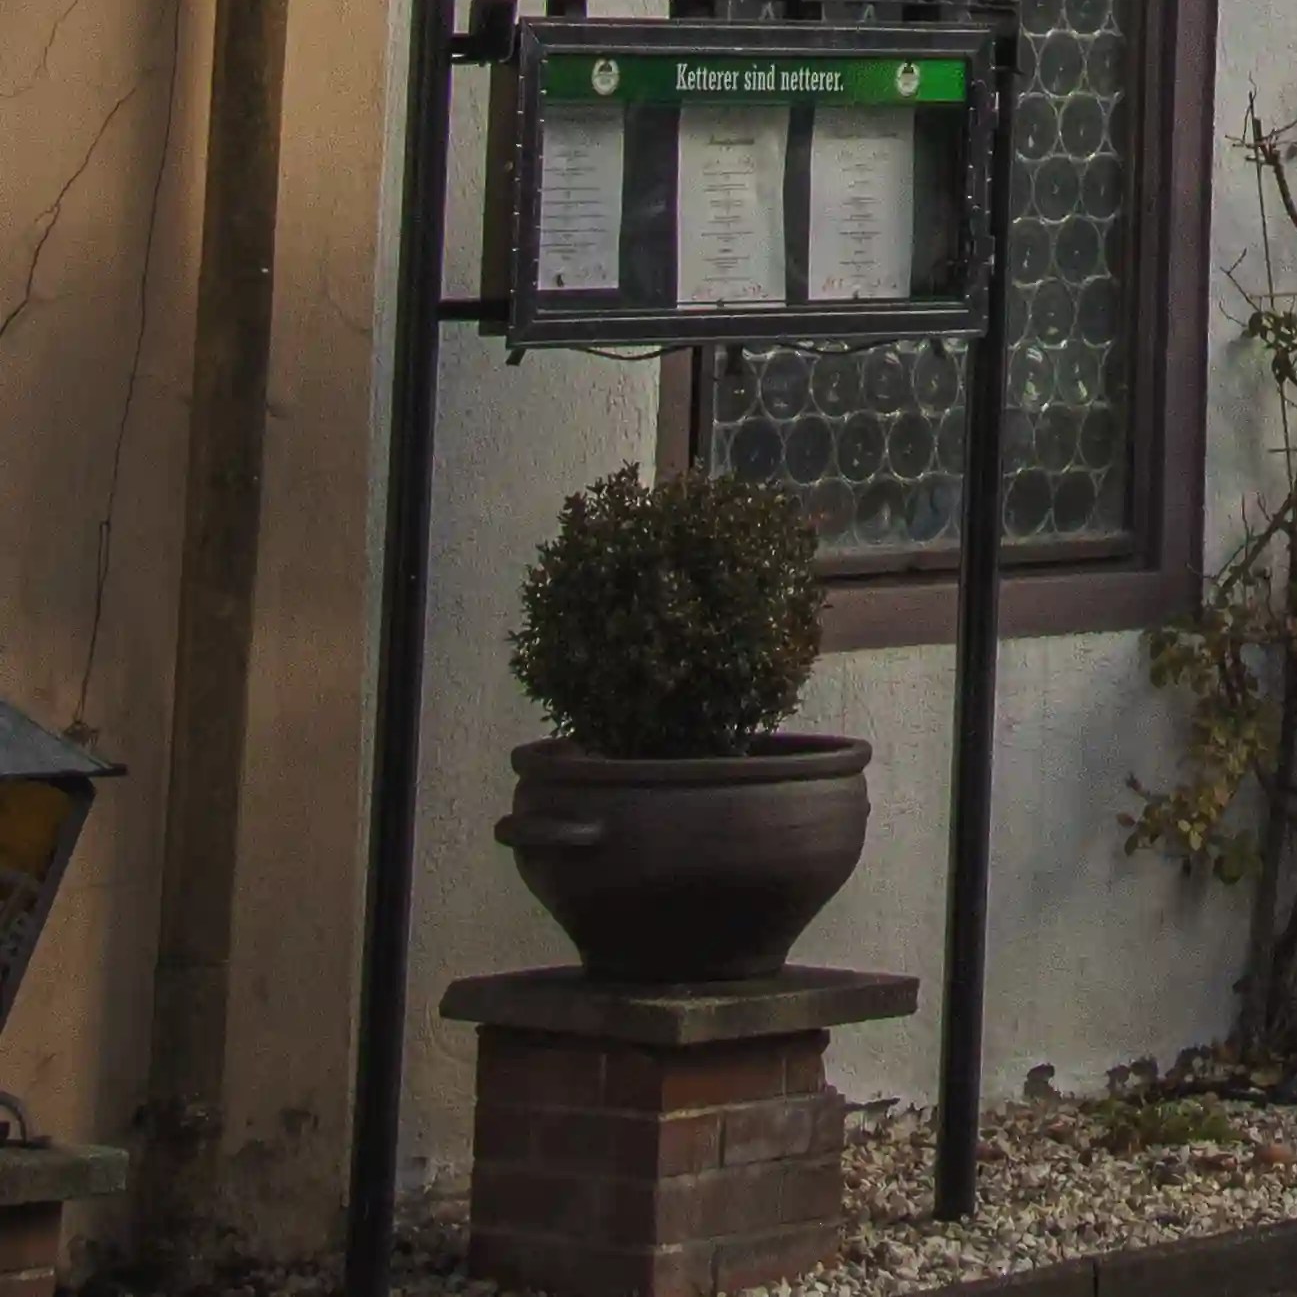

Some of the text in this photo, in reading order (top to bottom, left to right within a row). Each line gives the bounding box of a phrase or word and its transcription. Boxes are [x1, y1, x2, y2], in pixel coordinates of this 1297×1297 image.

[675, 63, 844, 91] Ketterer sind netterer.
